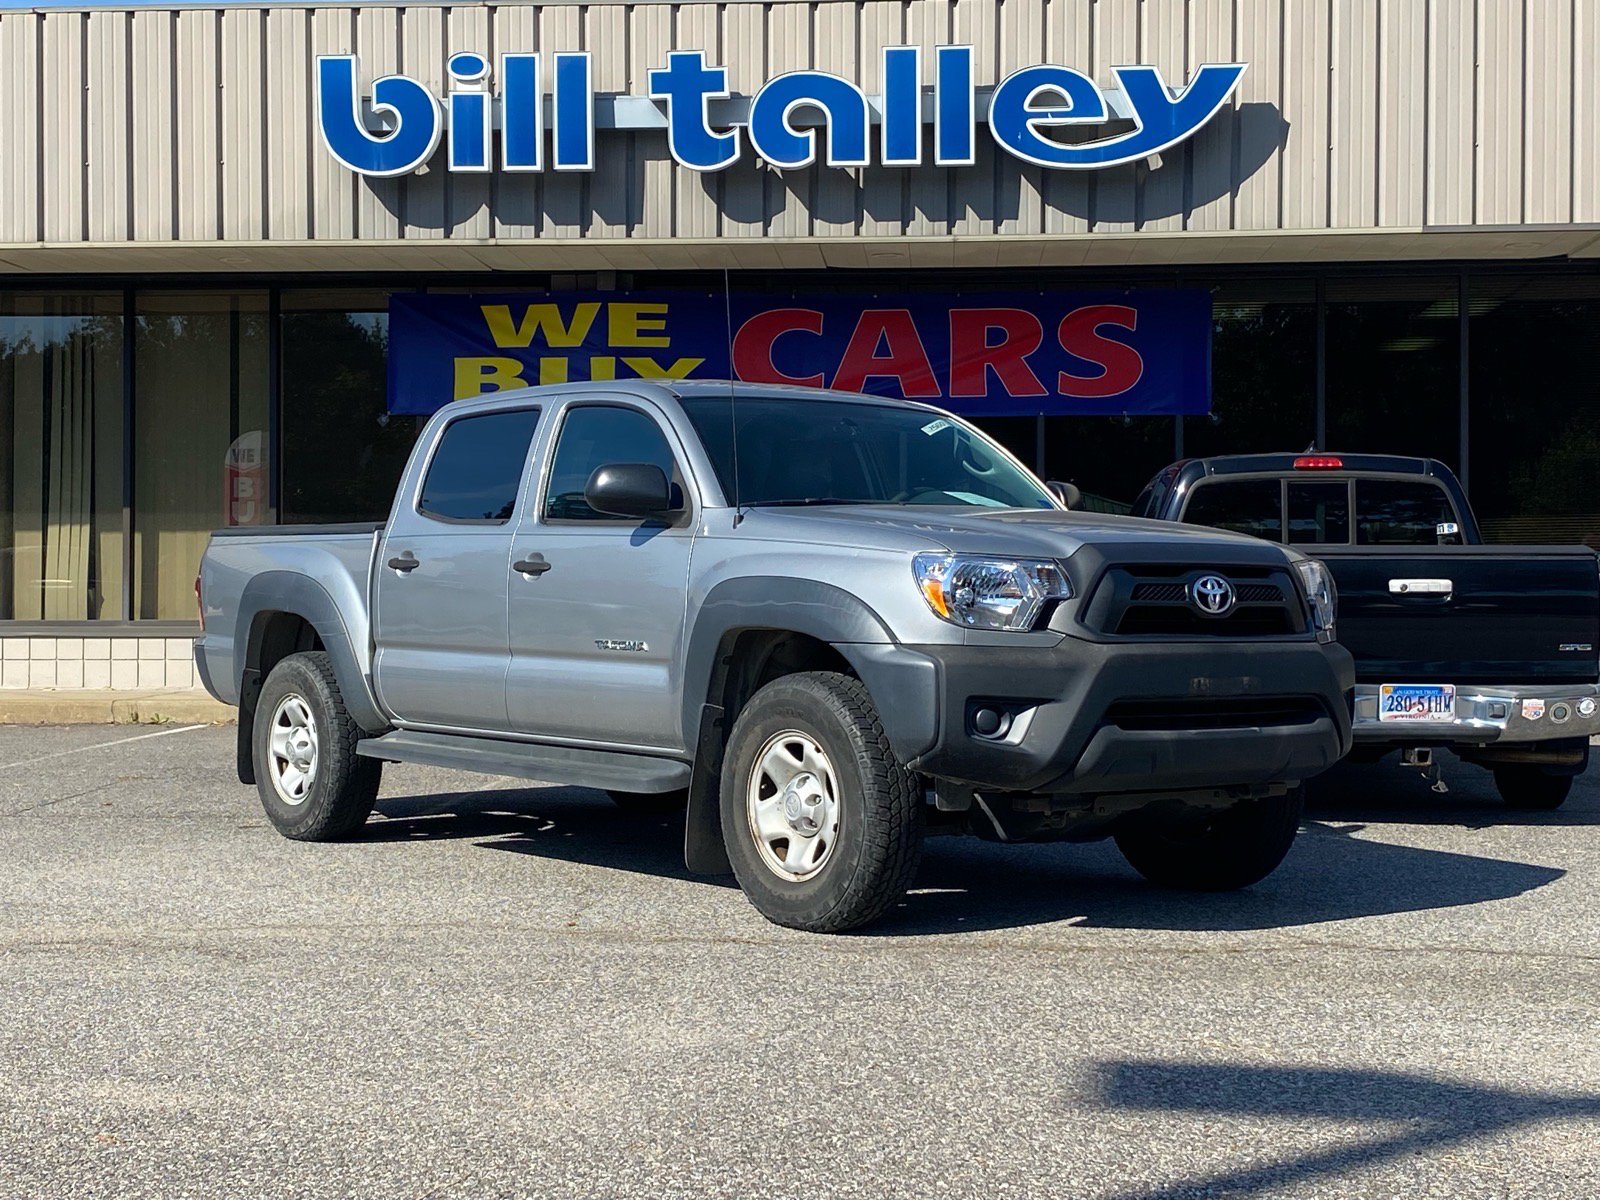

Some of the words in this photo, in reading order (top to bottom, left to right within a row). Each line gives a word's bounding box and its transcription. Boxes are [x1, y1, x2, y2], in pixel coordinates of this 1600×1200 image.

[316, 50, 595, 177] bill
[648, 44, 1249, 171] talley
[480, 302, 671, 348] WE
[732, 305, 1143, 398] CARS
